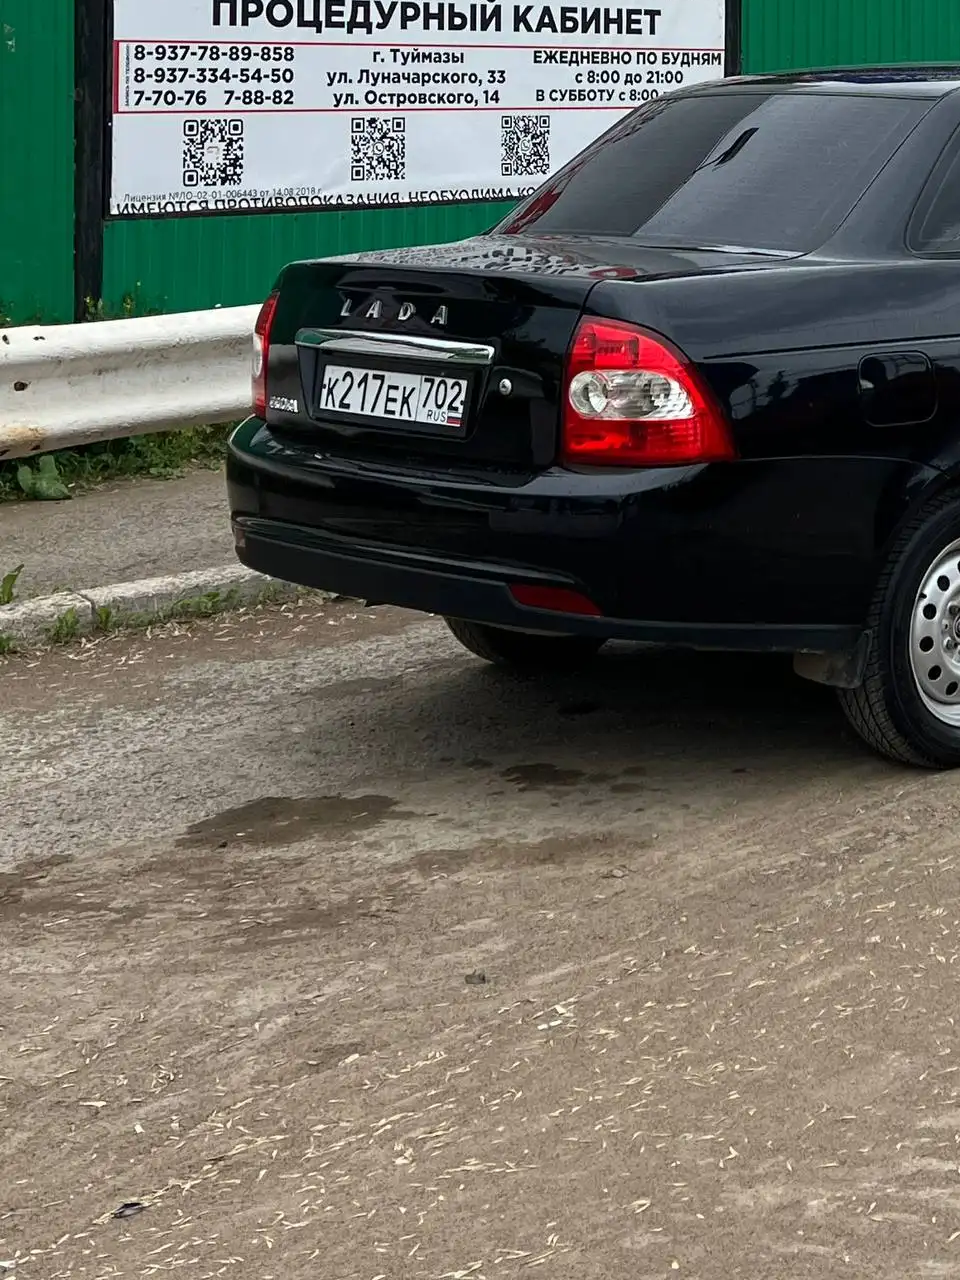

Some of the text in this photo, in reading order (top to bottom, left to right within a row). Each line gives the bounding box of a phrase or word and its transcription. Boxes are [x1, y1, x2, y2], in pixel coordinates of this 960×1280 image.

[514, 6, 662, 36] КАБИНЕТ
[133, 45, 295, 61] 8-937-78-89-858
[373, 49, 465, 68] г. Туймазы
[533, 50, 722, 67] ЕЖЕДНЕВНО ПО БУДНЯМ
[133, 67, 295, 84] 8-937-334-54-50
[326, 69, 506, 87] ул. Луначарского, 33
[575, 70, 684, 86] с 8:00 до 21:00
[133, 90, 295, 106] 7-70-76 7-88-82
[333, 90, 500, 107] ул. Островского, 14
[536, 89, 544, 102] В
[549, 89, 615, 102] СУББОТУ
[618, 91, 626, 102] с
[123, 193, 166, 202] Лицензия
[340, 299, 448, 325] LADA
[422, 377, 462, 412] 702
[427, 410, 447, 422] RUS
